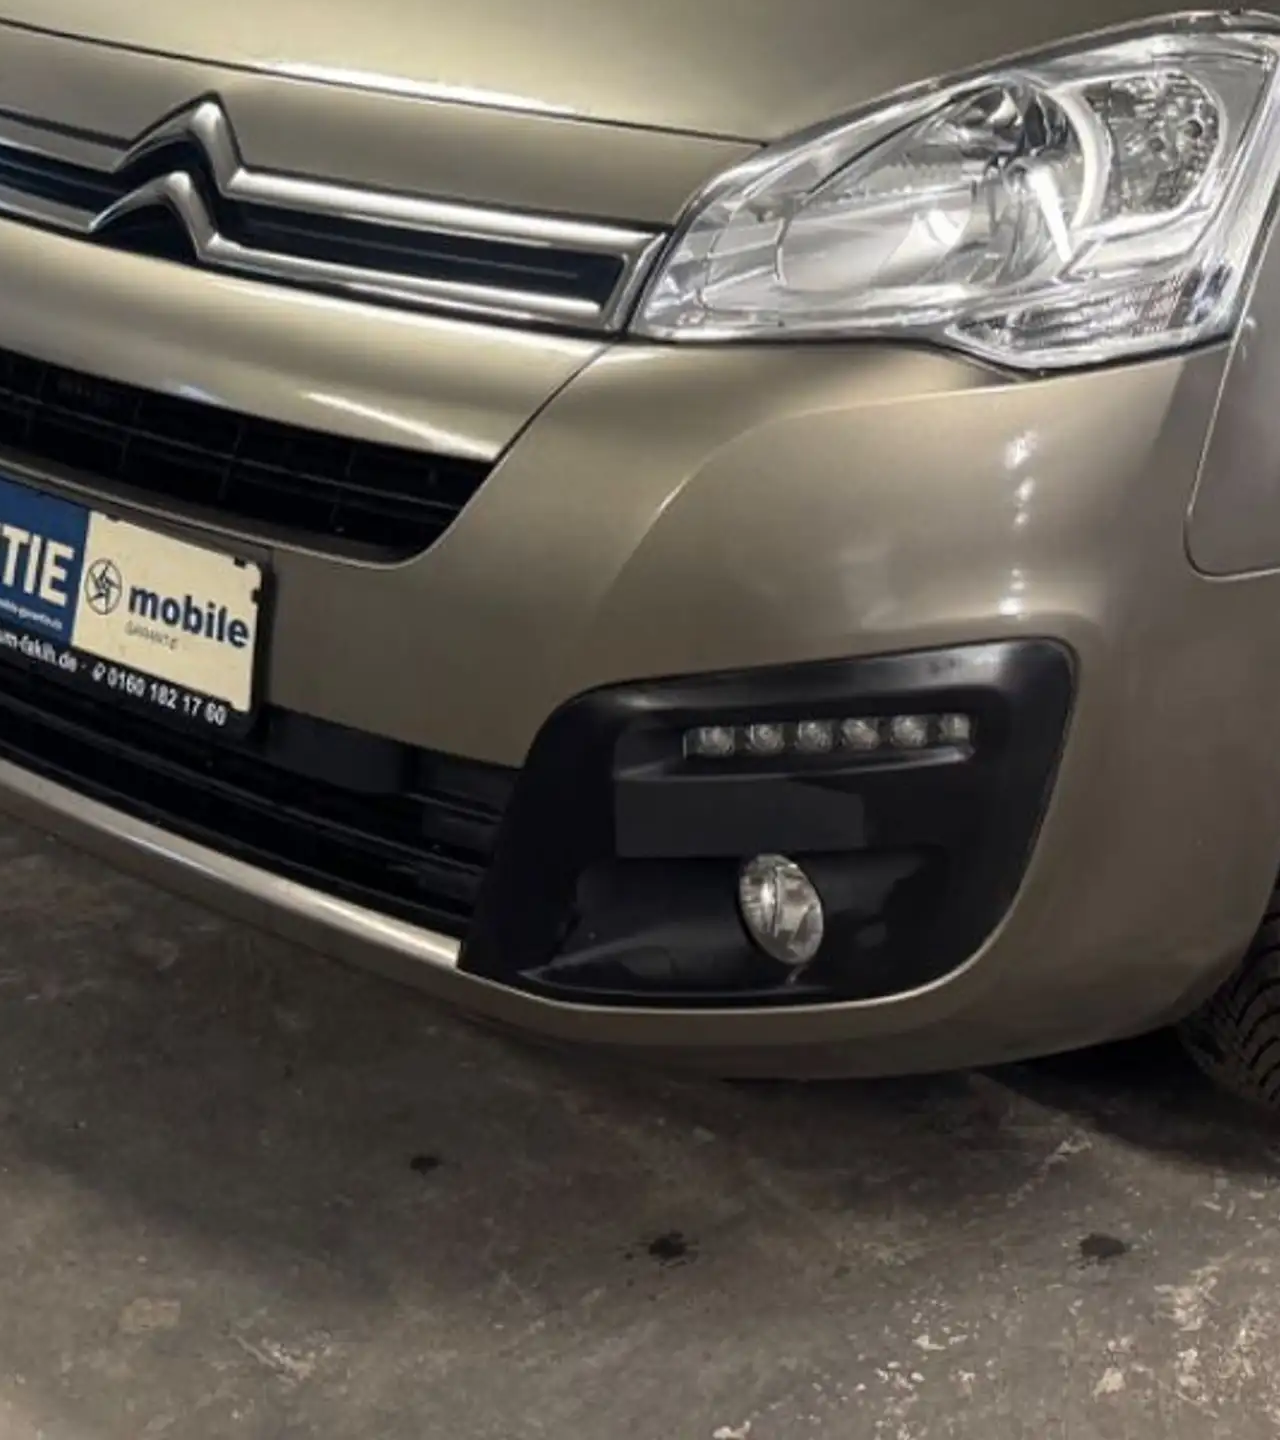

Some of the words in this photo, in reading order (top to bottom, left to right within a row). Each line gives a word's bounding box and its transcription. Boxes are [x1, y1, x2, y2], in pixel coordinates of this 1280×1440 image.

[127, 580, 250, 648] mobile
[150, 682, 179, 710] 182
[182, 693, 203, 717] 17
